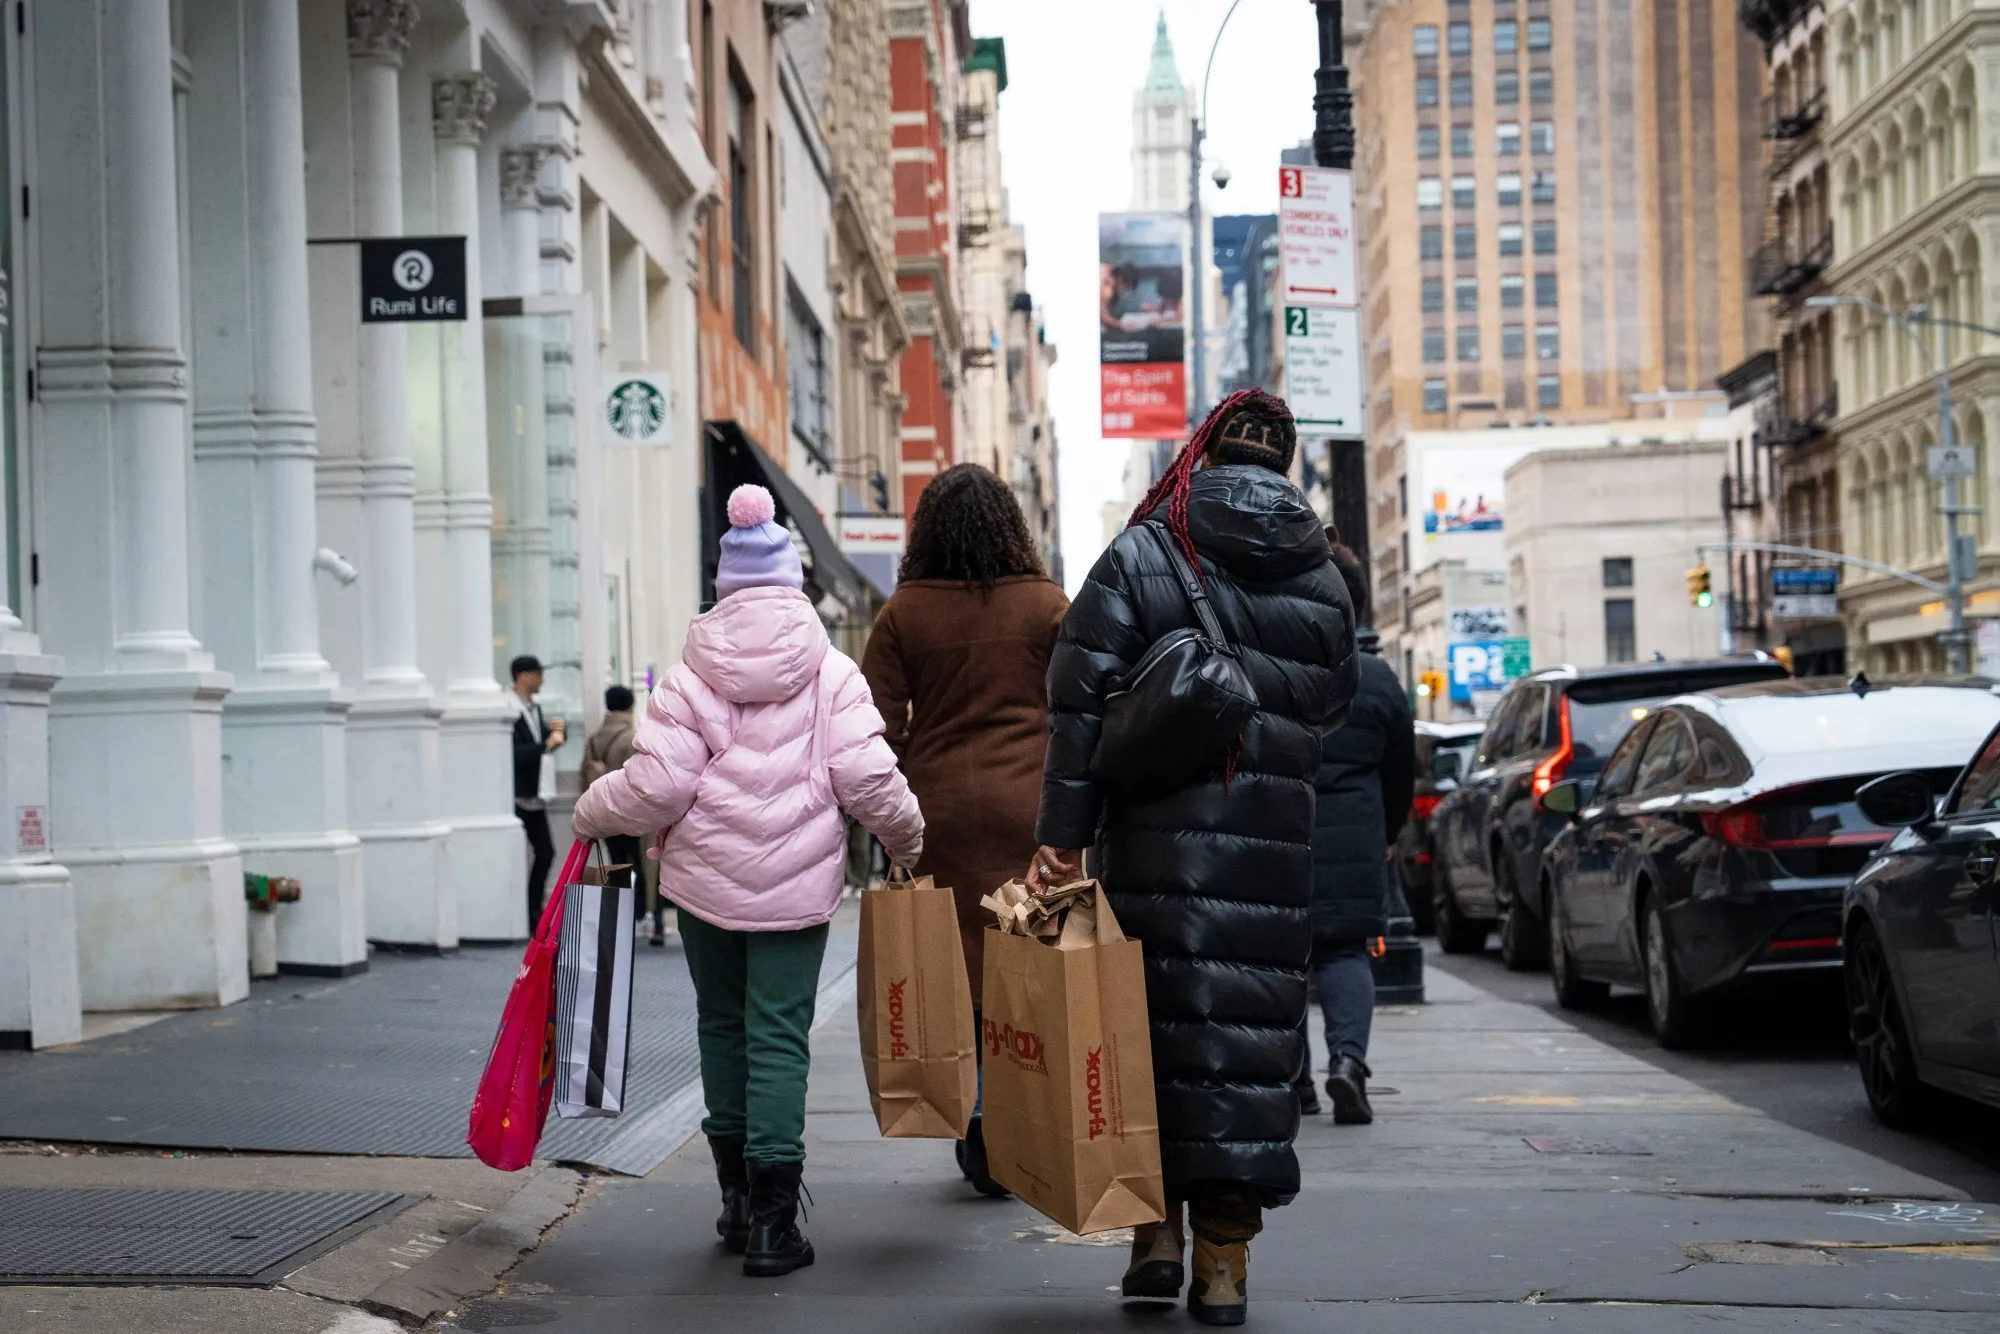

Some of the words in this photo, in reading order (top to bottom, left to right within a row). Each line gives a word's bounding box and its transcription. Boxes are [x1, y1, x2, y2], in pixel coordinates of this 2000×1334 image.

[1284, 170, 1299, 197] 3
[370, 297, 416, 316] Rumi
[421, 296, 458, 315] Life
[1290, 308, 1306, 335] 2
[1103, 369, 1132, 385] The
[1104, 388, 1121, 406] of
